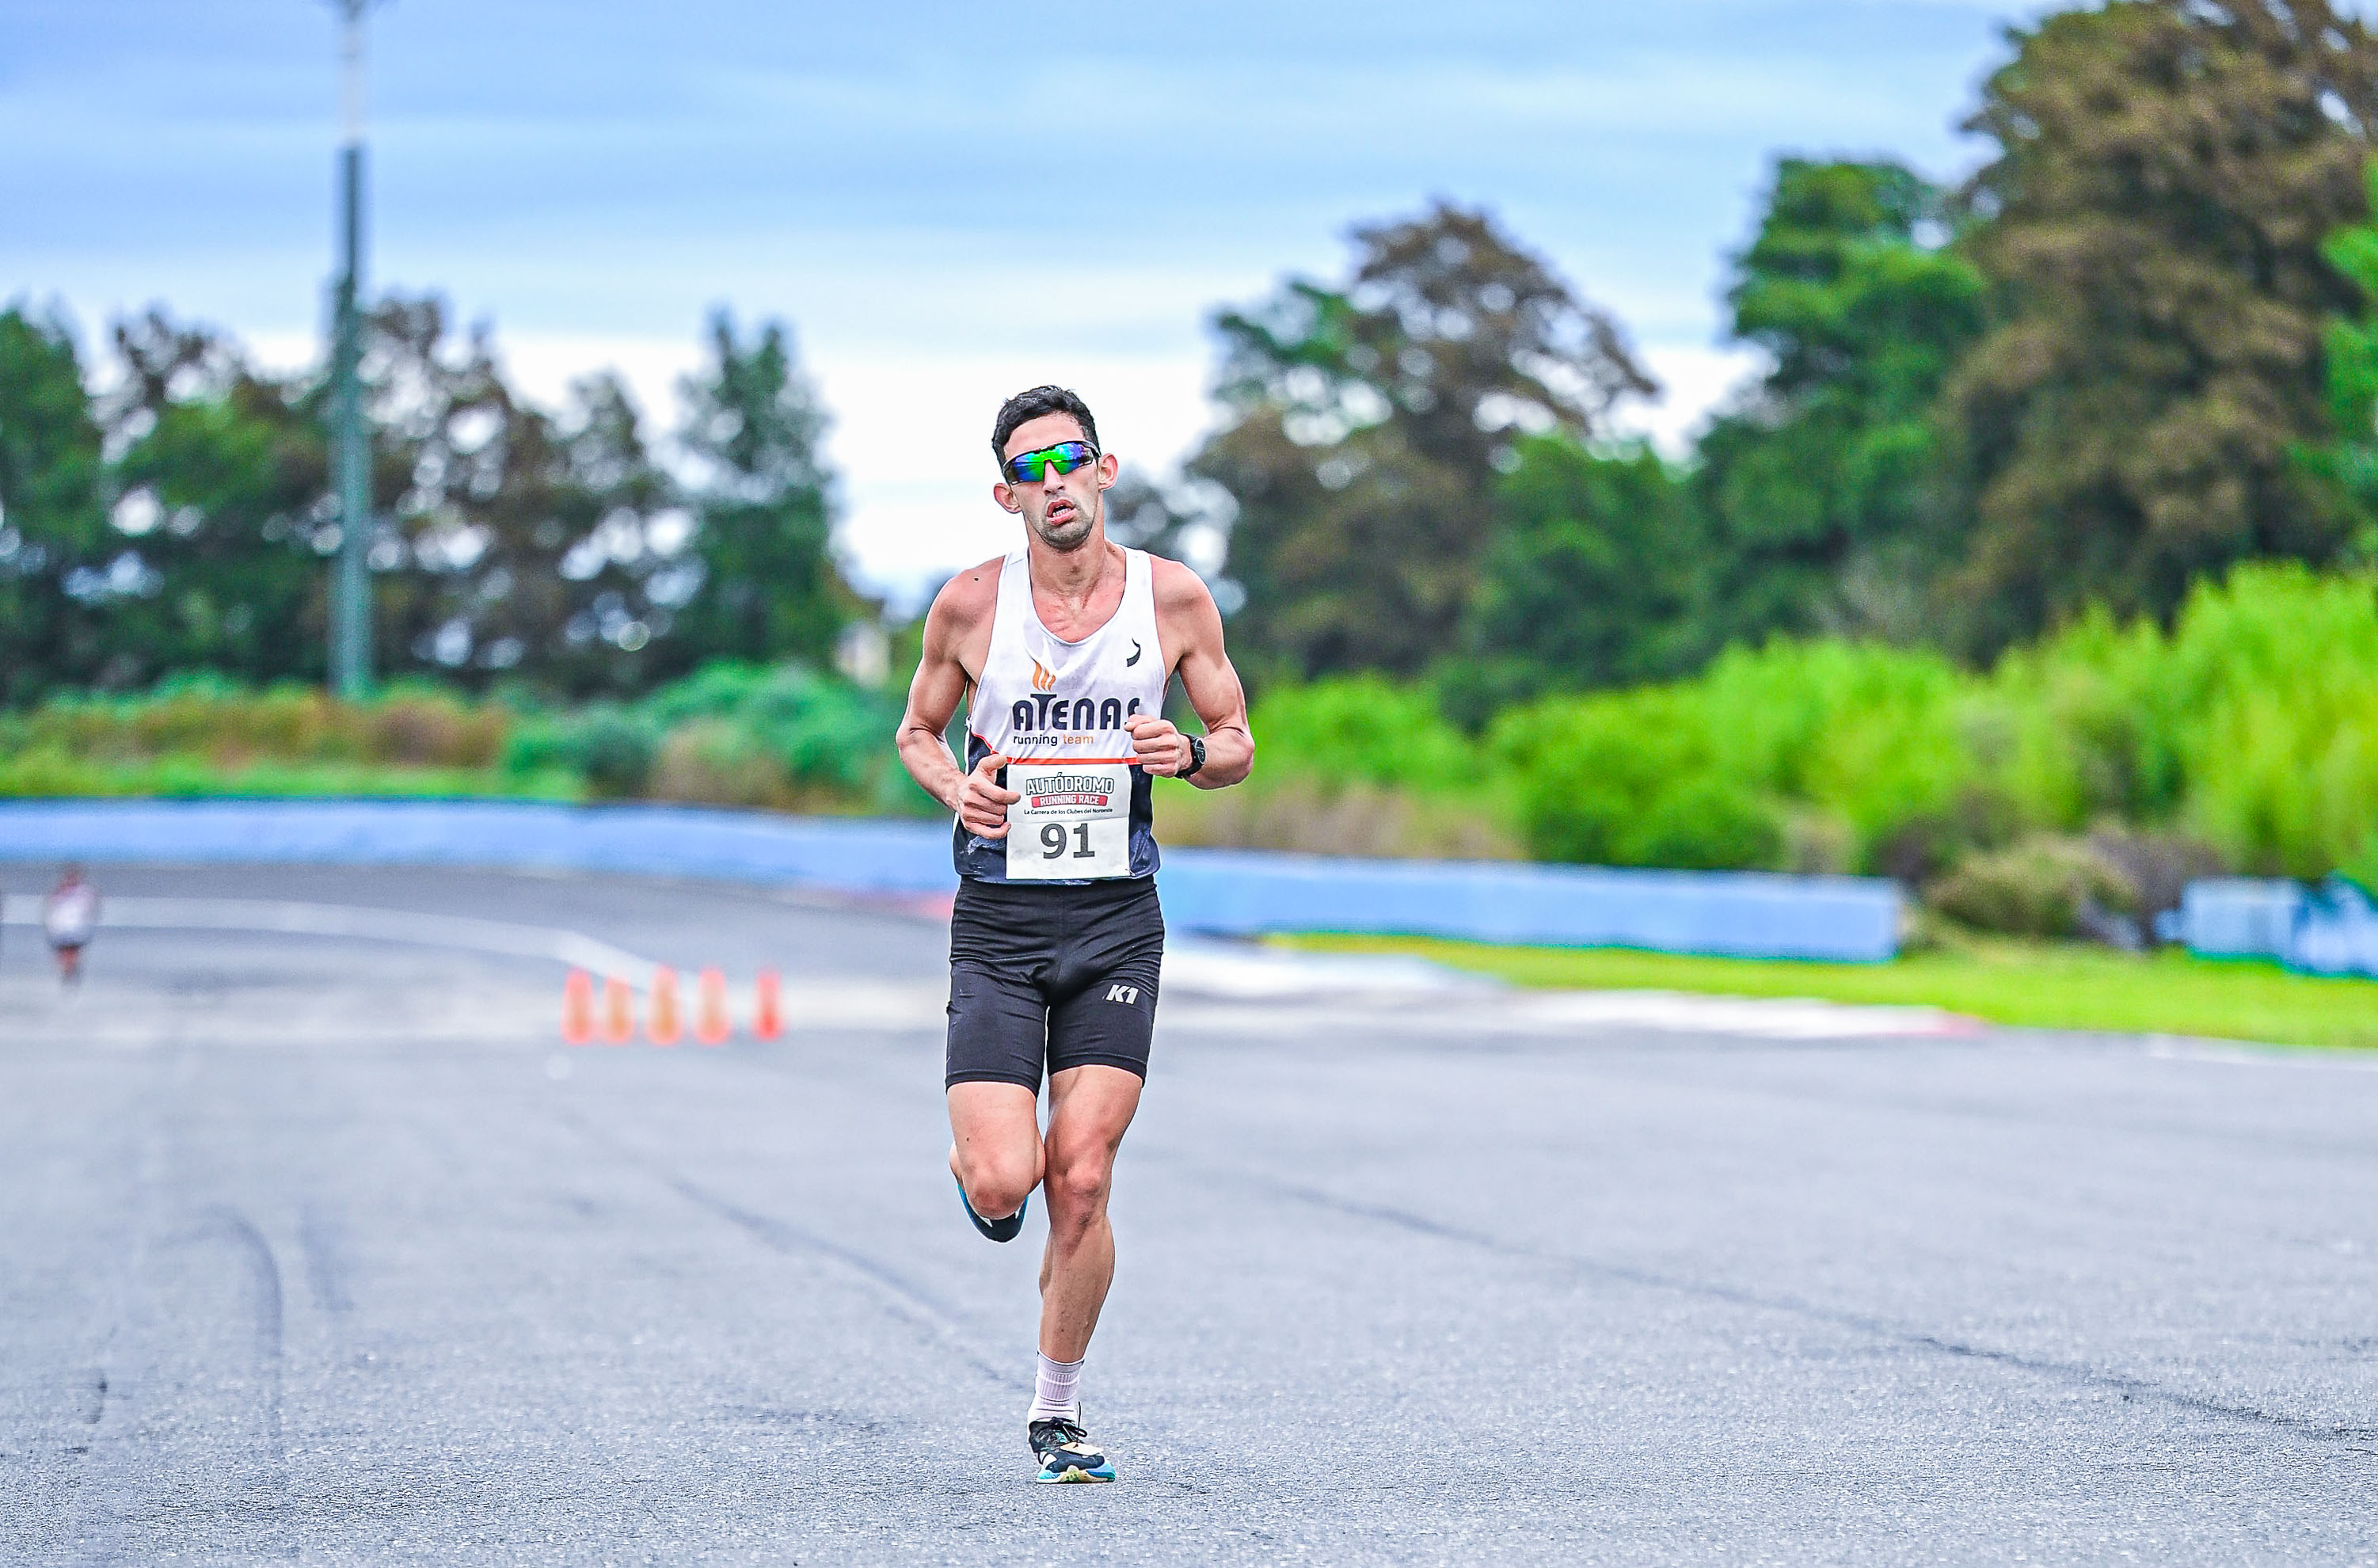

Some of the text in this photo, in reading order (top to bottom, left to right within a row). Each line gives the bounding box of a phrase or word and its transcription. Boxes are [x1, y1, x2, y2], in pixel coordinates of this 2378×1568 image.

[1014, 733, 1094, 746] running team
[1025, 771, 1114, 795] AUTÓDROMO
[1040, 795, 1100, 805] RUNNING RACE
[1040, 823, 1095, 859] 91
[1105, 984, 1139, 1004] K1
